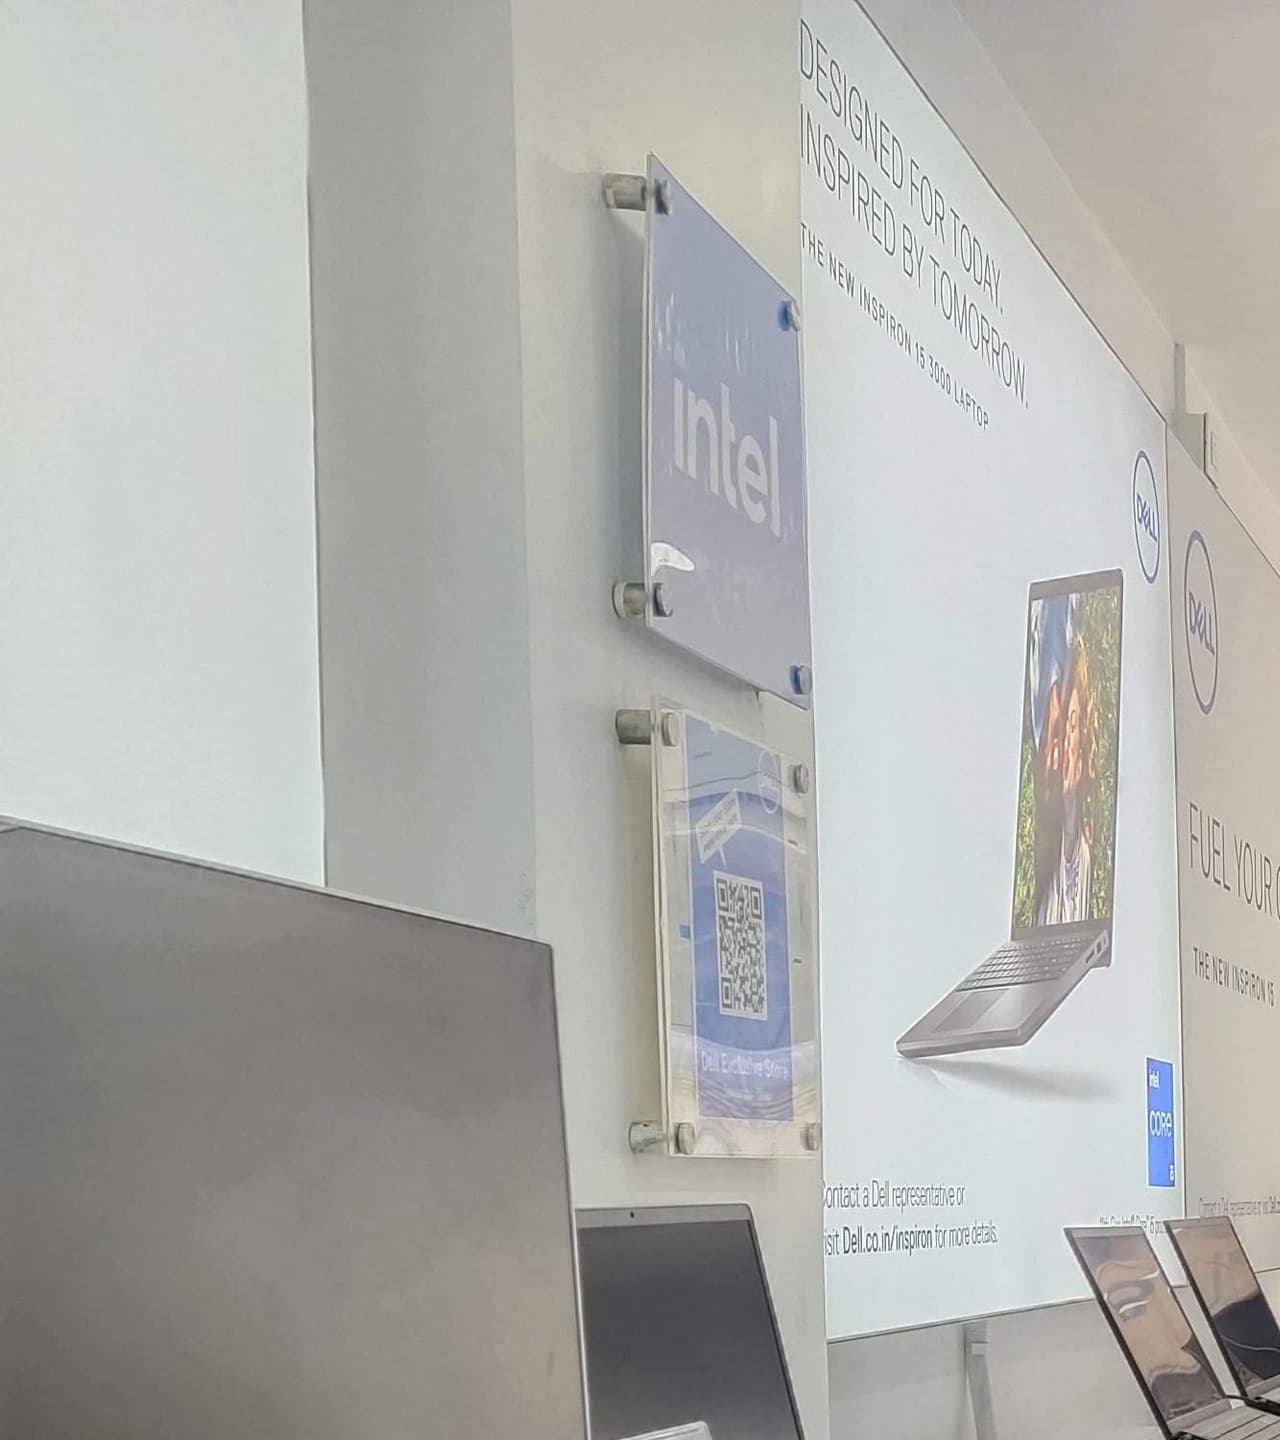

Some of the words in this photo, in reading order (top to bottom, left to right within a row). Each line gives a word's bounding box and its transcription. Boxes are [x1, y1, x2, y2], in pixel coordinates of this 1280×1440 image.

[800, 18, 904, 189] DESIGNED
[910, 157, 945, 245] FOR
[950, 207, 1004, 315] TODAY.
[800, 103, 896, 256] INSPIRED
[902, 223, 925, 288] BY
[929, 254, 1029, 409] TOMORROW.
[800, 222, 824, 267] THE
[829, 251, 855, 298] NEW
[859, 284, 912, 356] INSPIRON
[915, 341, 926, 369] 15
[928, 355, 951, 395] 3000
[954, 381, 989, 430] LAPTOP
[674, 376, 782, 538] intel
[1136, 492, 1158, 542] DELL
[1188, 591, 1215, 656] DELL
[1189, 801, 1231, 892] FUEL
[1234, 833, 1272, 917] YOUR
[1193, 946, 1210, 981] THE
[1212, 955, 1230, 989] NEW
[1232, 960, 1266, 1002] INSPIRON
[824, 1183, 860, 1208] ontact
[863, 1187, 869, 1208] a
[872, 1179, 890, 1208] Dell
[892, 1183, 955, 1214] representative
[956, 1186, 966, 1206] or
[843, 1224, 933, 1256] Dell.co.in/inspiron
[935, 1224, 947, 1248] for
[949, 1226, 970, 1247] more
